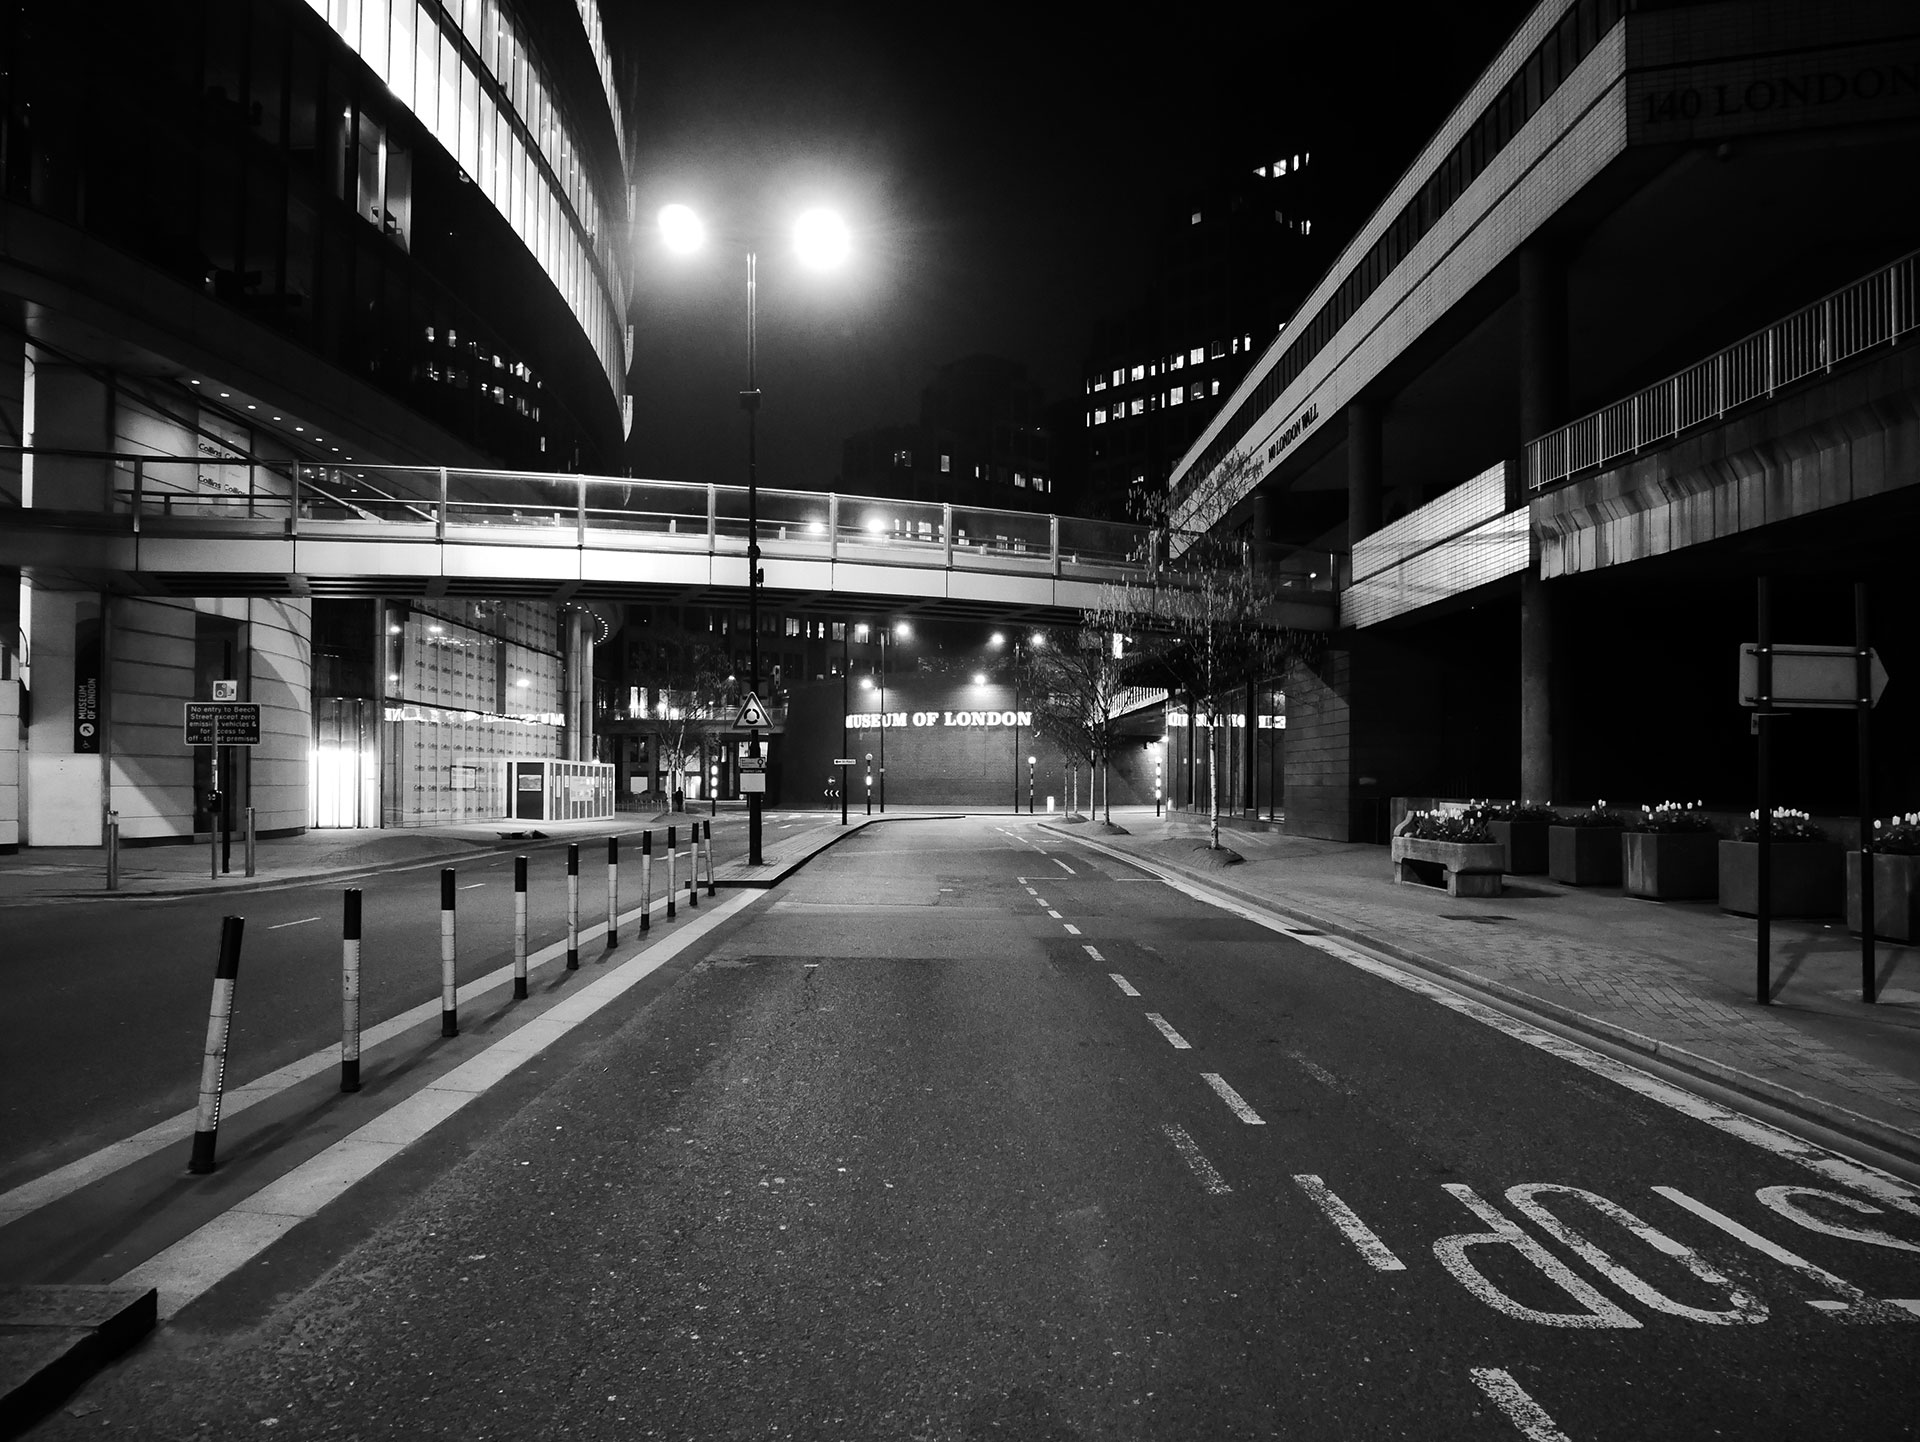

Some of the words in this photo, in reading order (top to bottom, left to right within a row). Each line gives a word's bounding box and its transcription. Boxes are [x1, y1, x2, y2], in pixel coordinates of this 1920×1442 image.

[1645, 88, 1701, 123] 140
[1715, 63, 1920, 116] LONDON
[1276, 418, 1301, 456] LONDON
[1301, 403, 1319, 431] WALL
[198, 443, 222, 458] Collins
[198, 474, 221, 489] Collins
[78, 685, 87, 719] MUSEUM
[88, 678, 96, 708] LONDON
[87, 709, 96, 719] OF
[912, 712, 939, 727] OF
[944, 711, 1032, 727] LONDON
